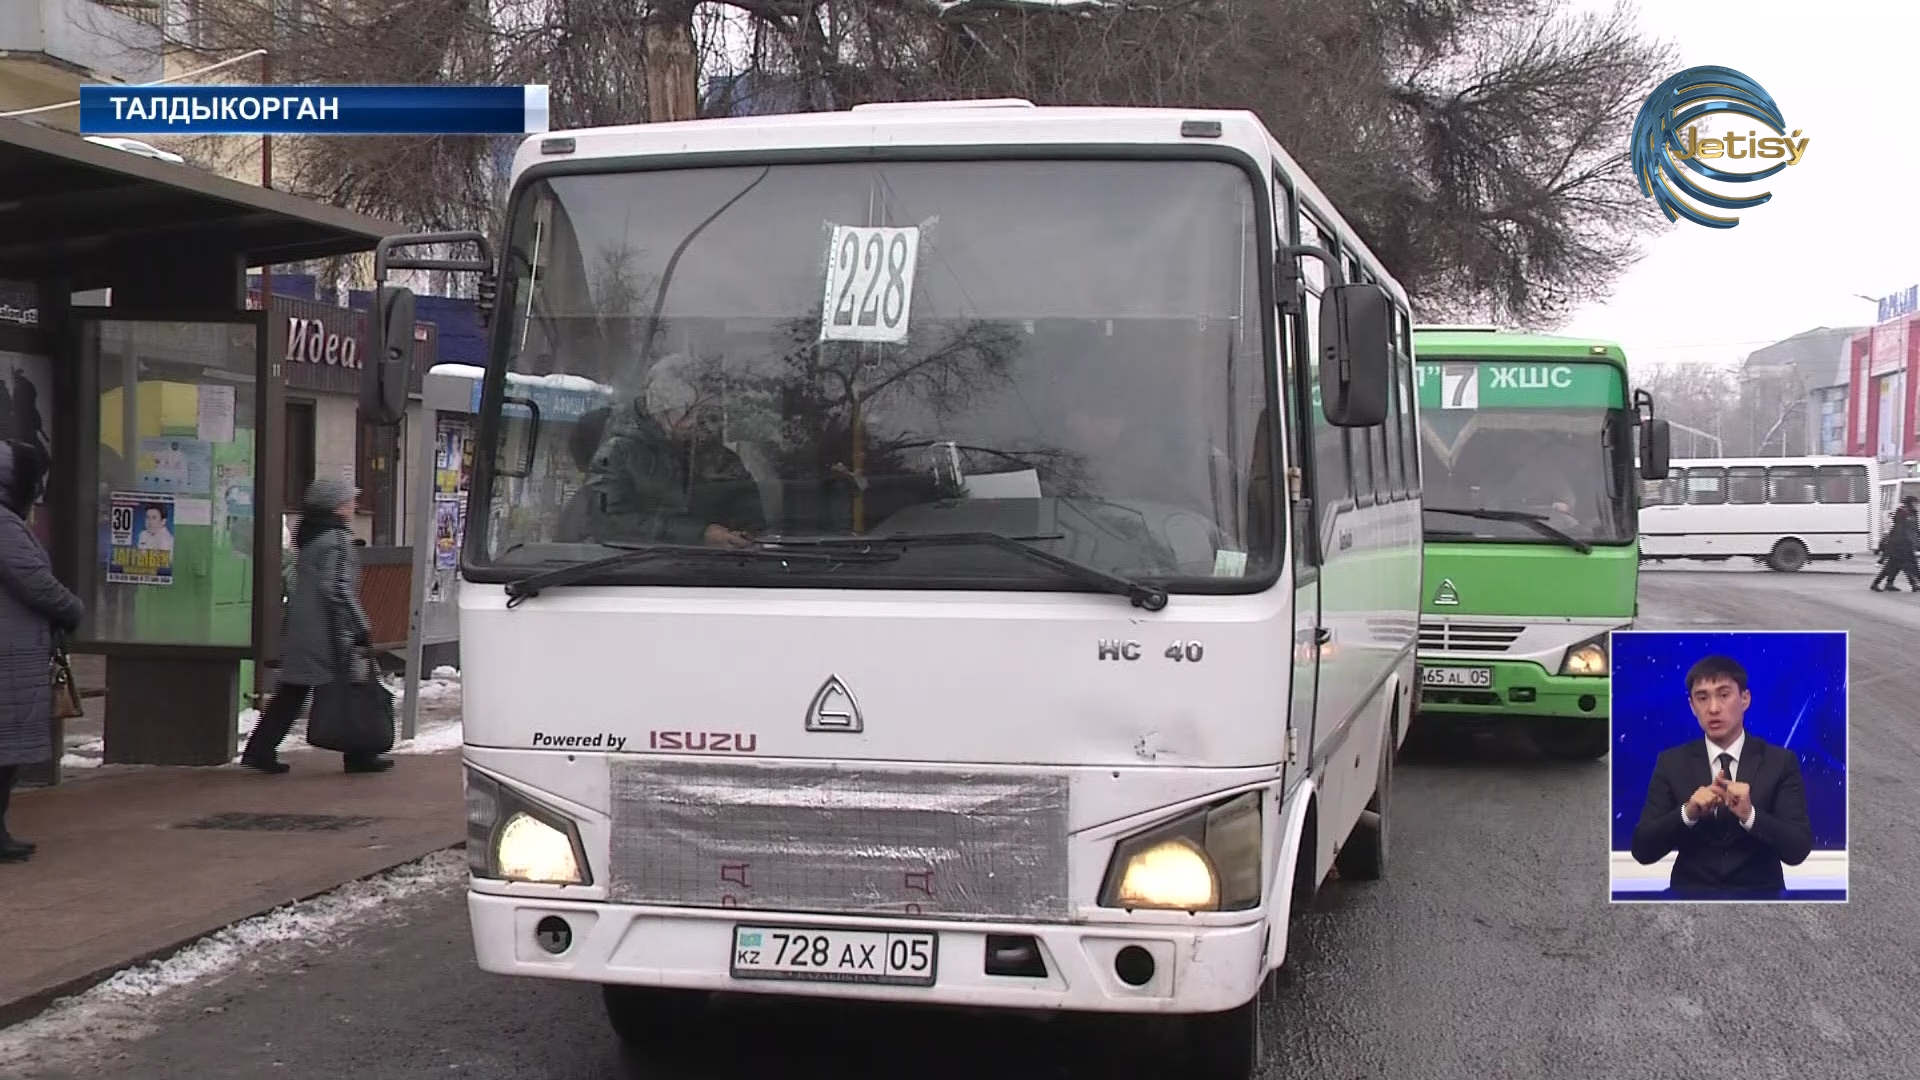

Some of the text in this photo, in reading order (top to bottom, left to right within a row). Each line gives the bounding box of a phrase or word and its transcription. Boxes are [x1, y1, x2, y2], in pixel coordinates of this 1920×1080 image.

[833, 231, 907, 328] 228
[1445, 367, 1475, 406] 7
[1489, 365, 1572, 389] ЖШС
[113, 508, 131, 531] 30
[1098, 639, 1204, 662] HC 40
[1423, 669, 1489, 684] 65 AL 05
[532, 730, 757, 752] Powered by ISUZU
[737, 933, 929, 971] KZ 728 AX 05
